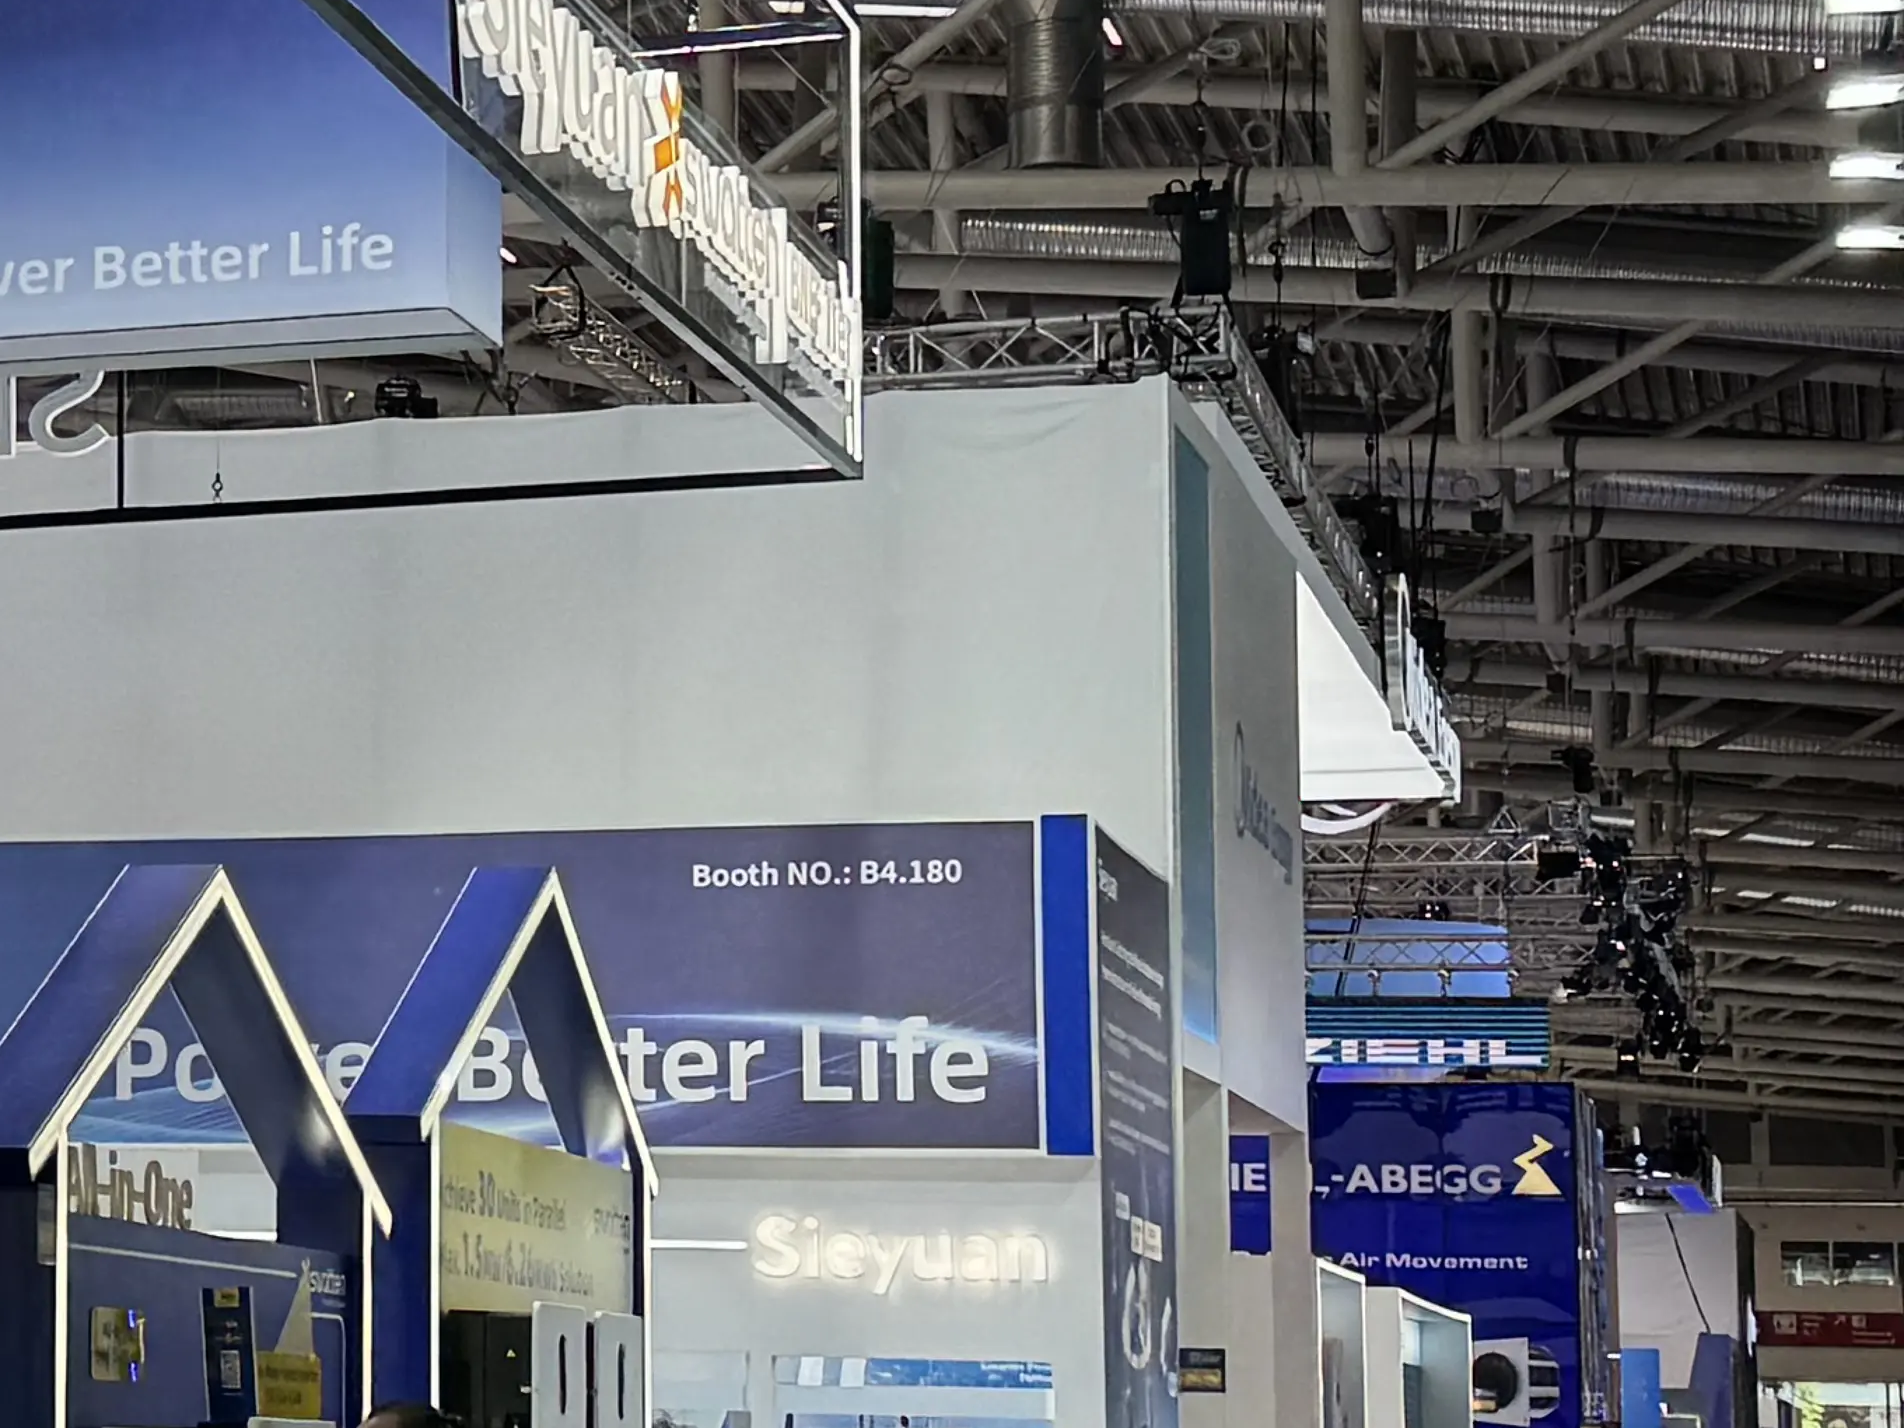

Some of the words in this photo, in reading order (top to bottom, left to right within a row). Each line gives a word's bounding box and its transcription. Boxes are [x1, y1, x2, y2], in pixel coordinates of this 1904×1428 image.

[94, 237, 271, 291] Better
[290, 224, 393, 275] Life
[692, 861, 778, 887] Booth
[787, 860, 852, 887] NO.:
[860, 859, 962, 886] B4.180
[457, 1025, 764, 1103] Bter
[801, 1018, 989, 1104] Life
[753, 1216, 1051, 1295] Sieyuan
[1341, 1252, 1379, 1269] Air
[1385, 1252, 1528, 1270] Movement
